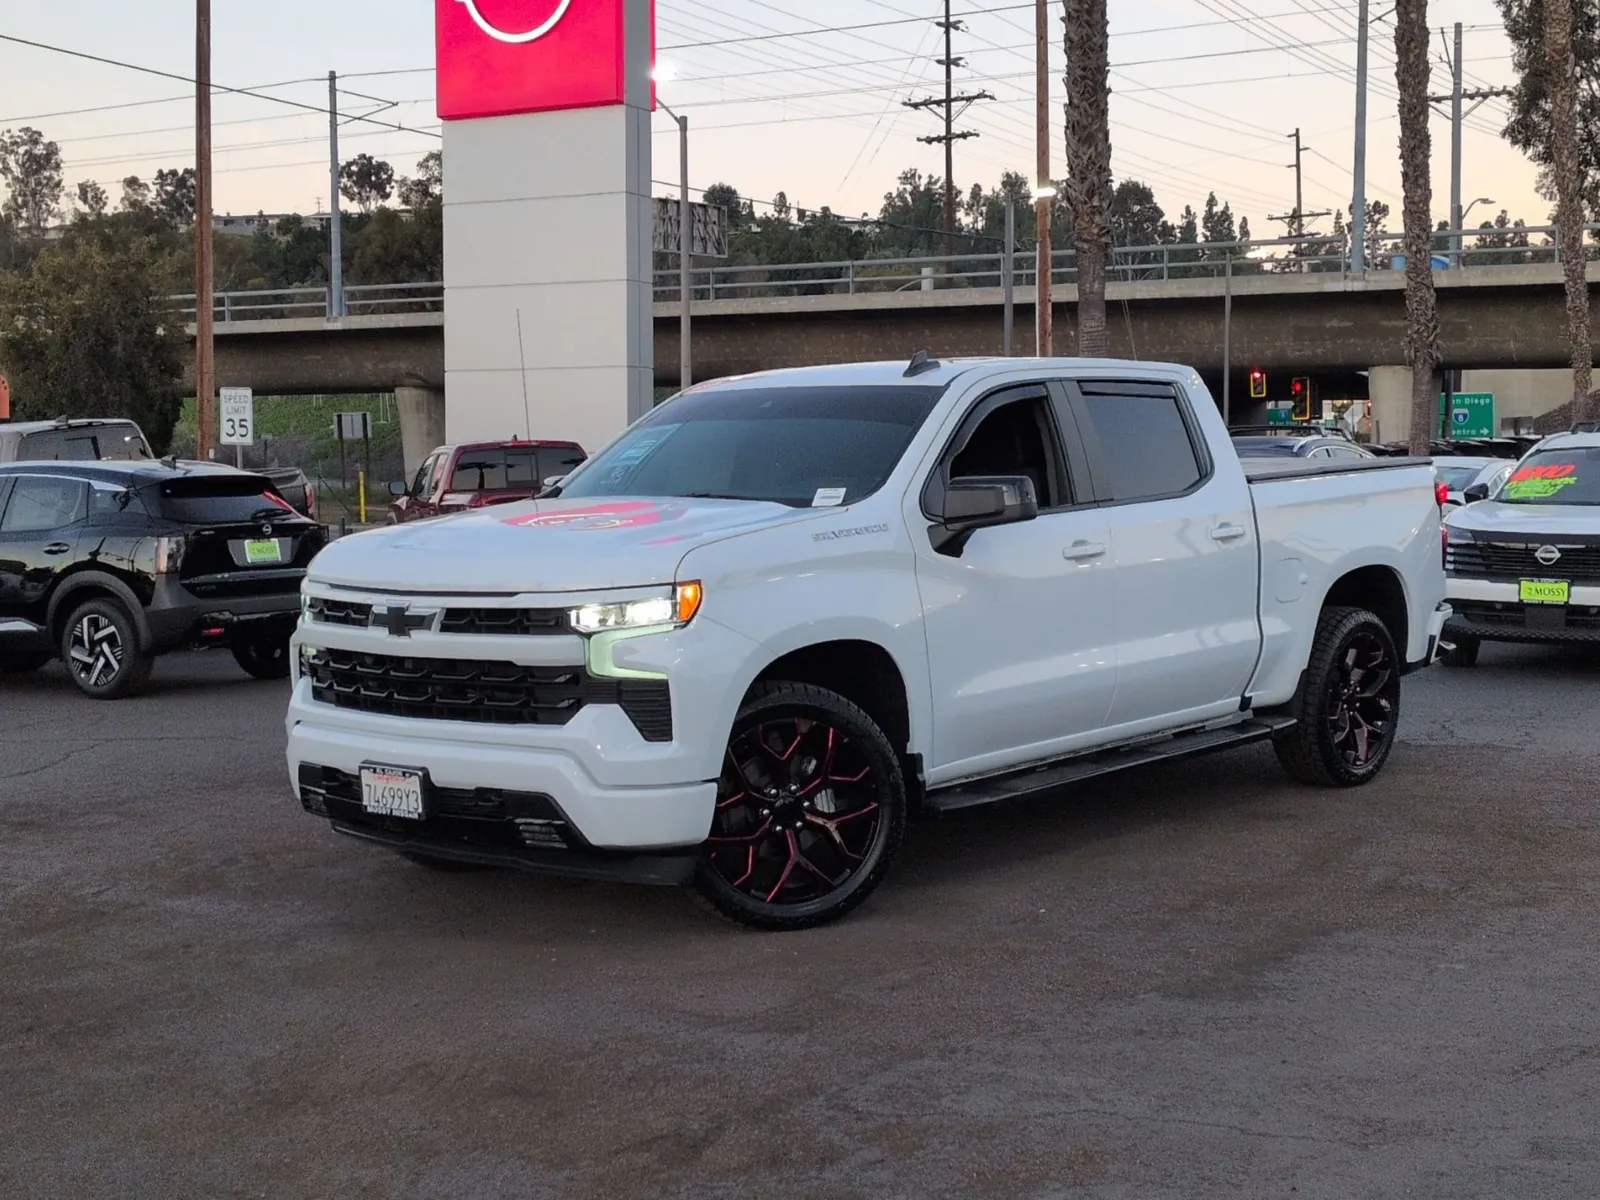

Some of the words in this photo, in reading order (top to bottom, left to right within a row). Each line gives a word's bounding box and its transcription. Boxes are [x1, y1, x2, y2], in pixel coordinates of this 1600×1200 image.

[223, 395, 249, 404] SPEED
[1464, 398, 1490, 406] Diego
[226, 405, 246, 414] LIMIT
[1457, 414, 1464, 422] 8
[225, 417, 249, 438] 35
[1535, 587, 1566, 597] MOSSY
[364, 783, 419, 811] 74699Y3
